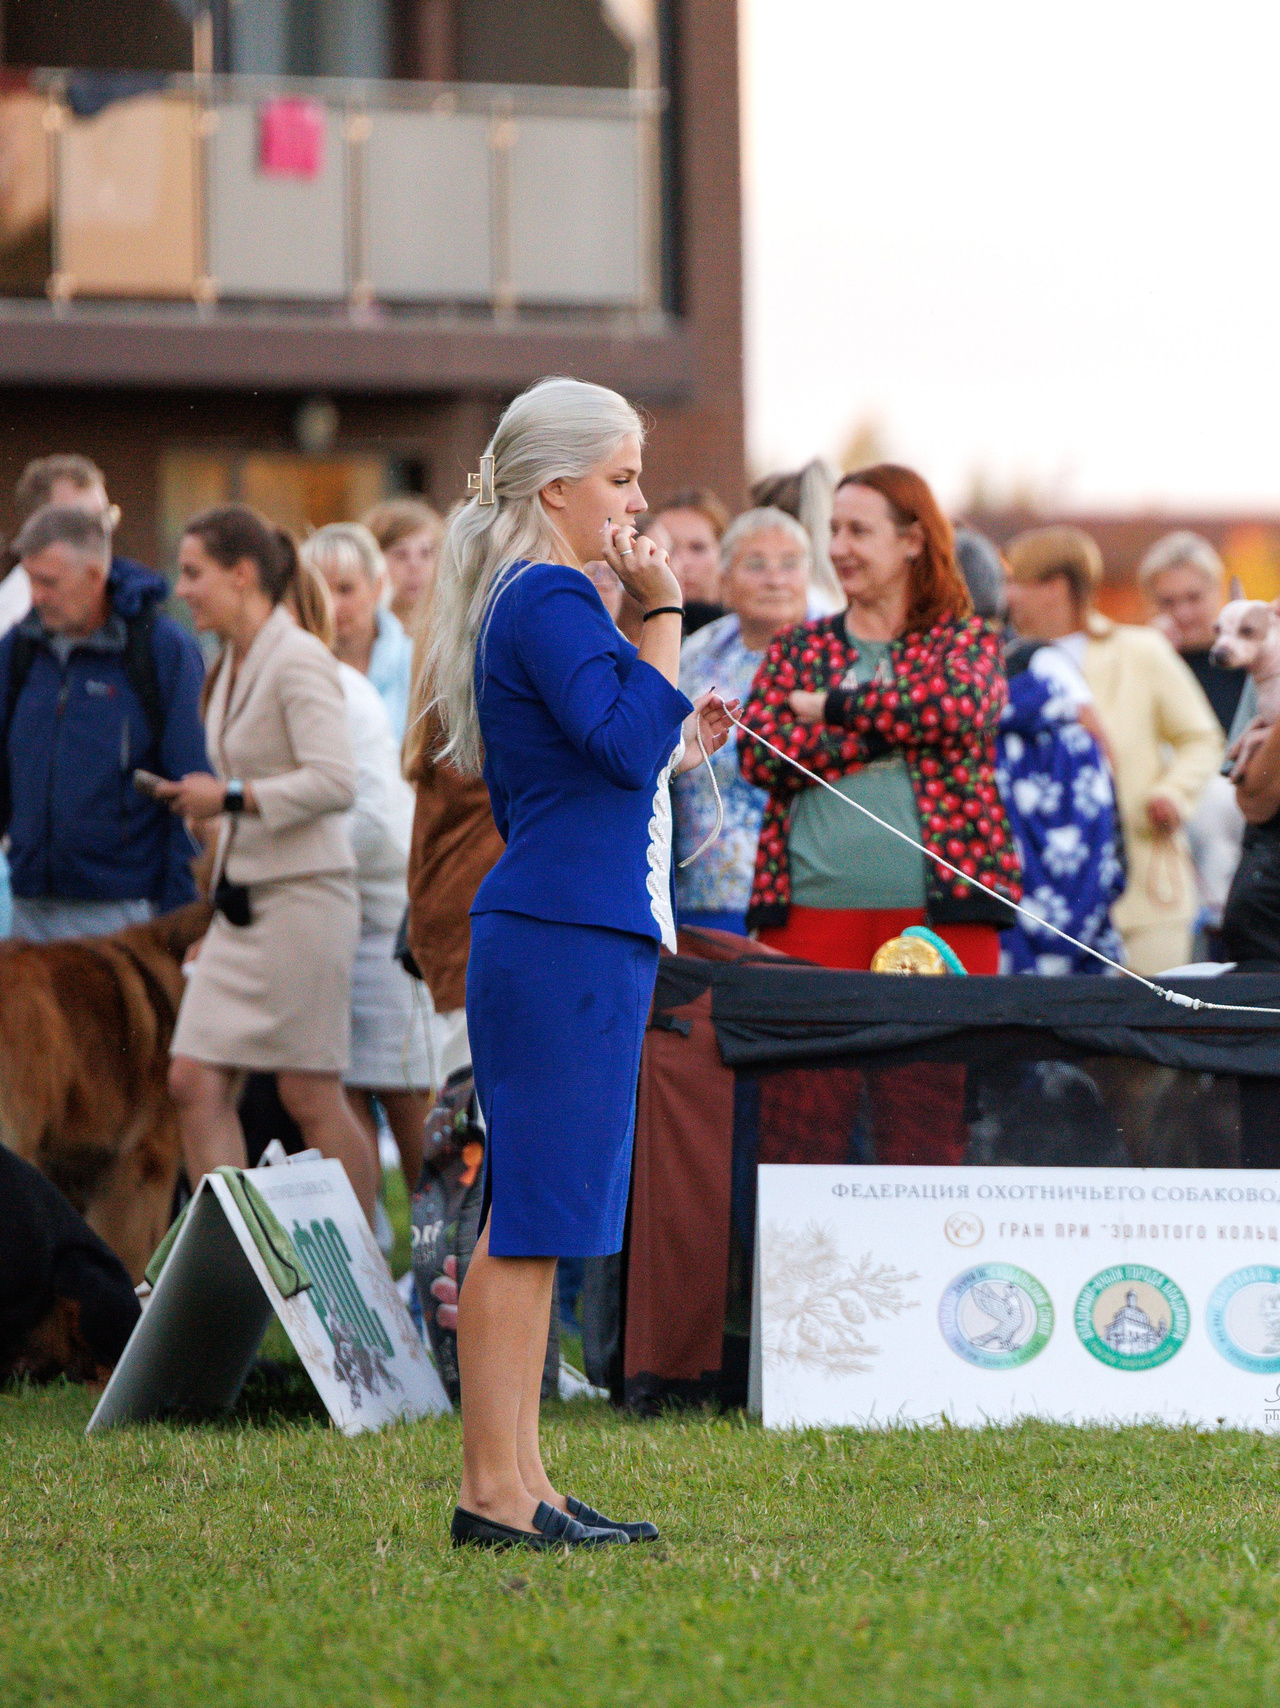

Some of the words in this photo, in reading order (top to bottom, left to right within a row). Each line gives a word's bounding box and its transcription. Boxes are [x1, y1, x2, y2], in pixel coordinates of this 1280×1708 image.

[831, 1183, 970, 1200] ФЕДЕРАЦИЯ
[976, 1184, 1147, 1202] ОХОТНИЧЬЕГО
[999, 1222, 1045, 1239] ГРАН
[1055, 1222, 1090, 1239] ПРИ
